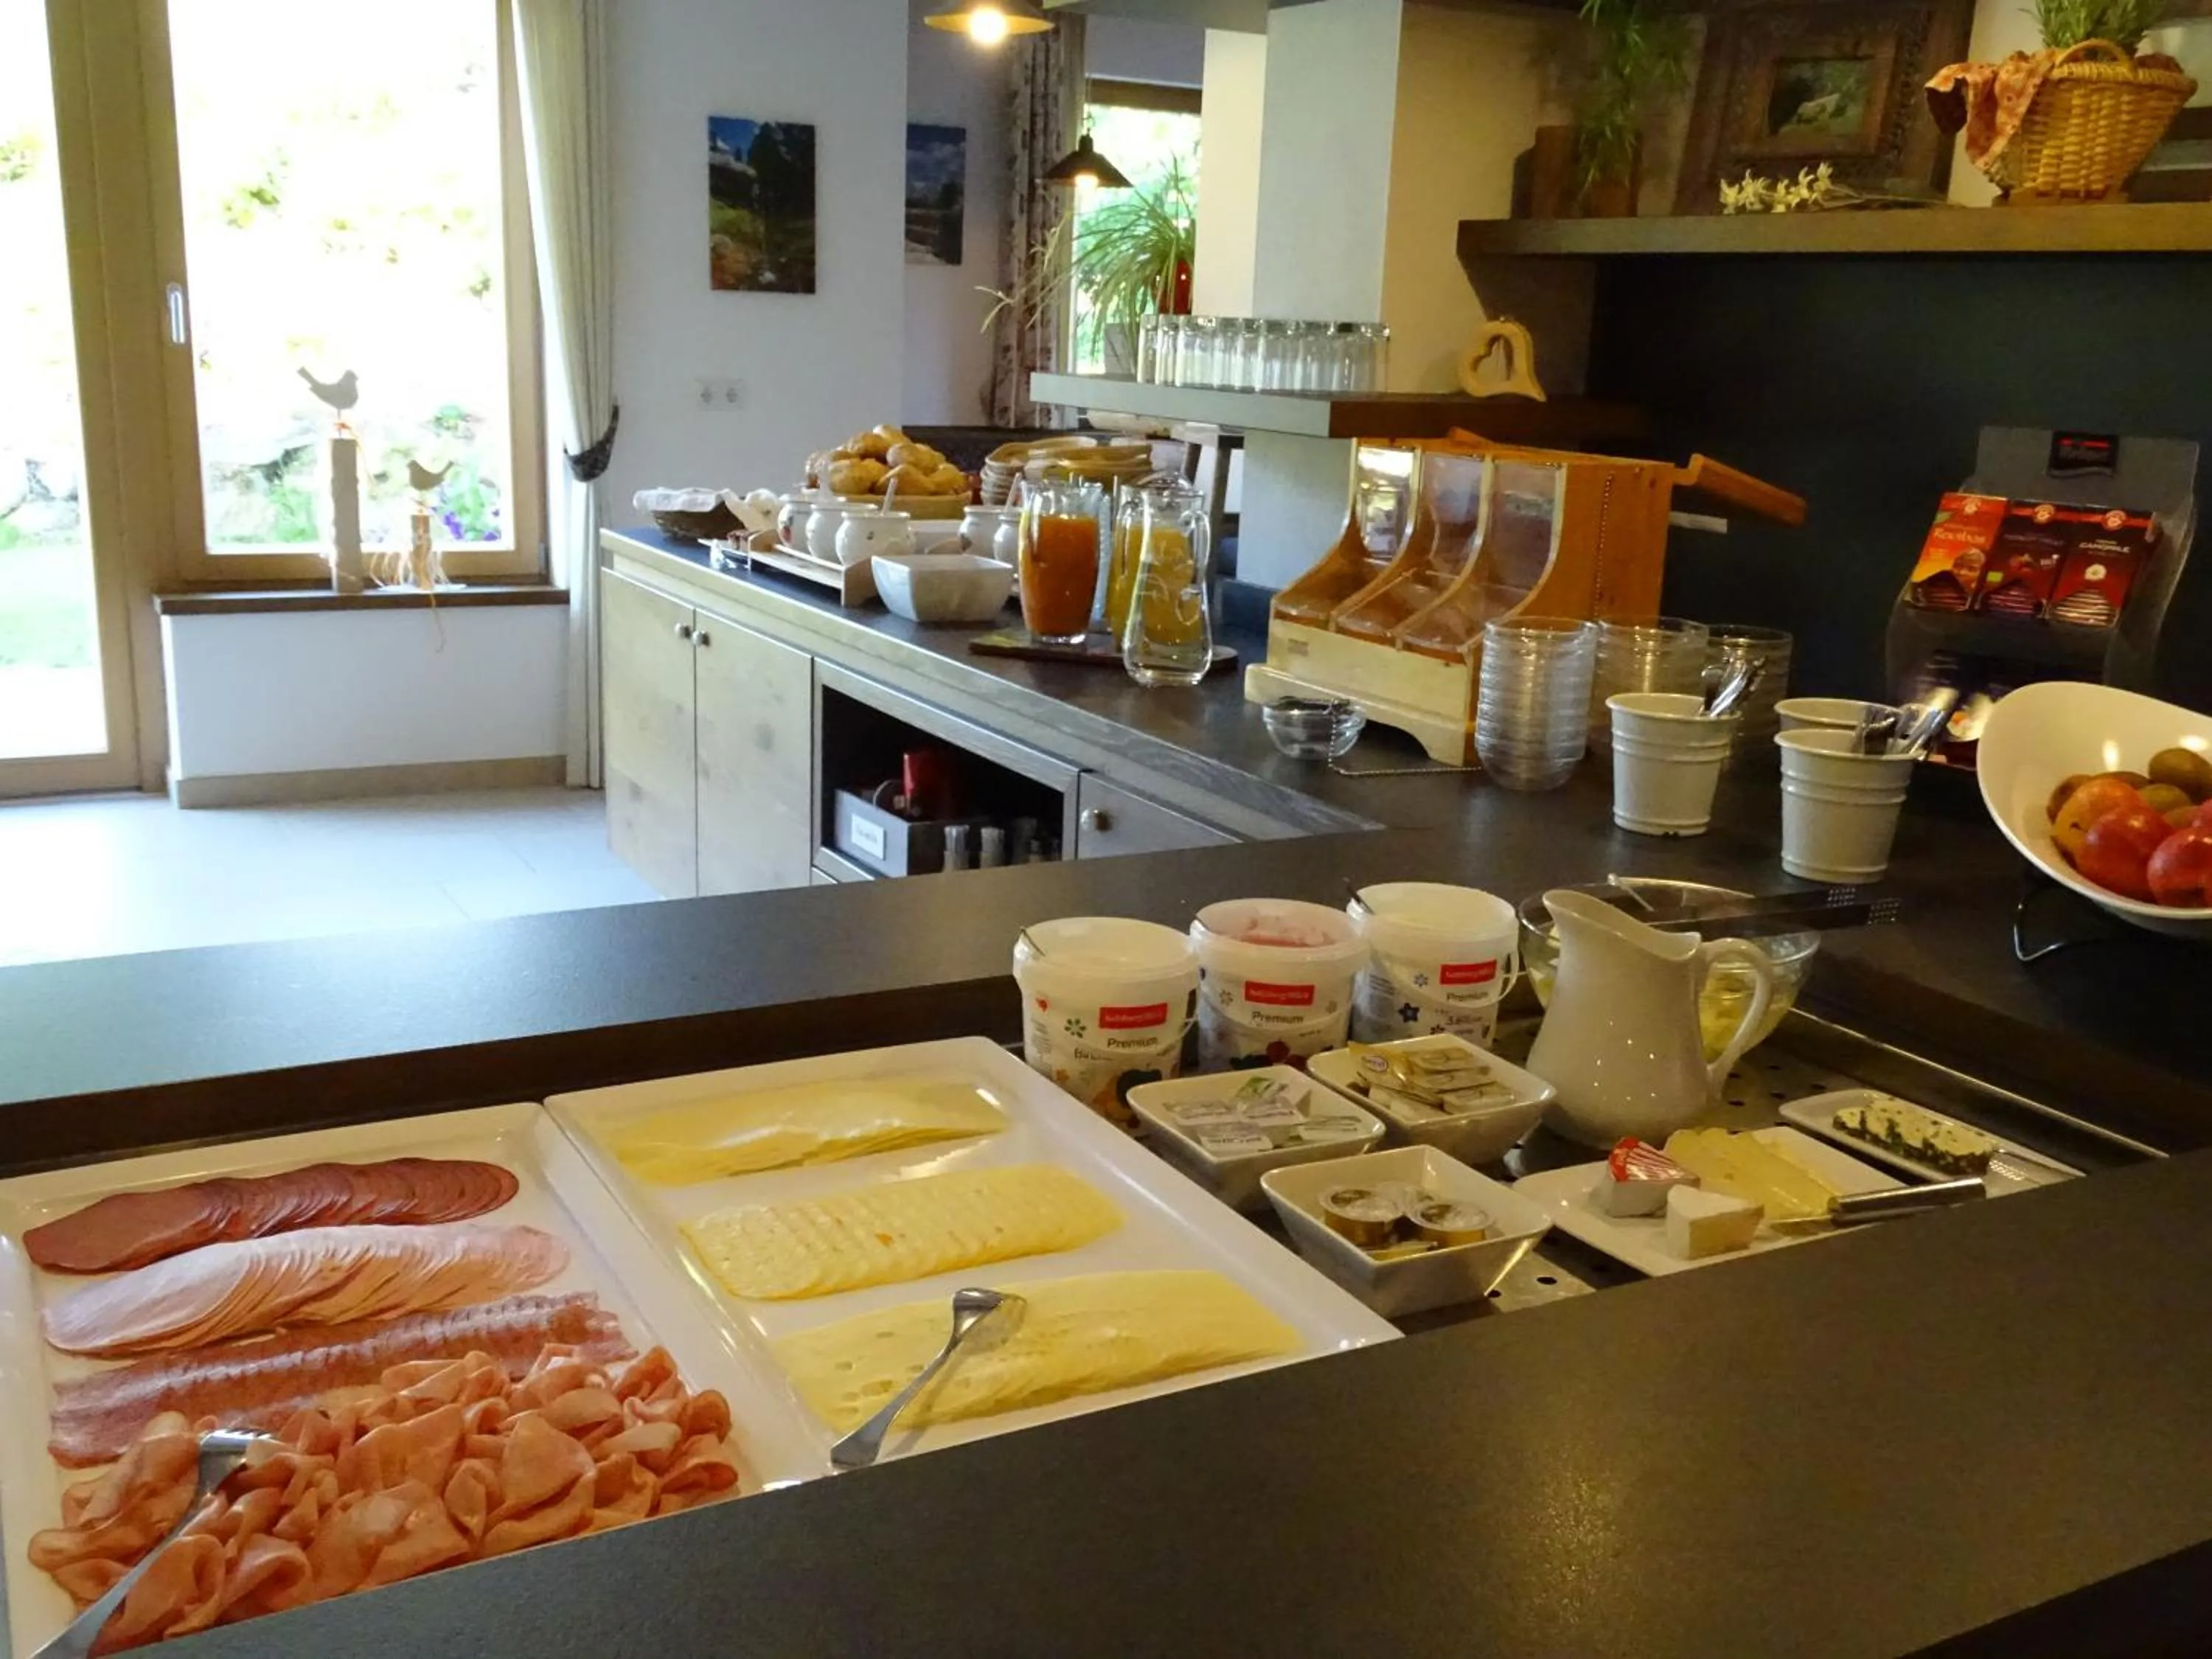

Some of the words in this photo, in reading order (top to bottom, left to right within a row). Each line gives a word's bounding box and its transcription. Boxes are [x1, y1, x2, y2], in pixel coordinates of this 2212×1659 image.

[1447, 991, 1489, 1001] Premium
[1251, 1011, 1304, 1024] Premium
[1107, 1037, 1158, 1049] Premium
